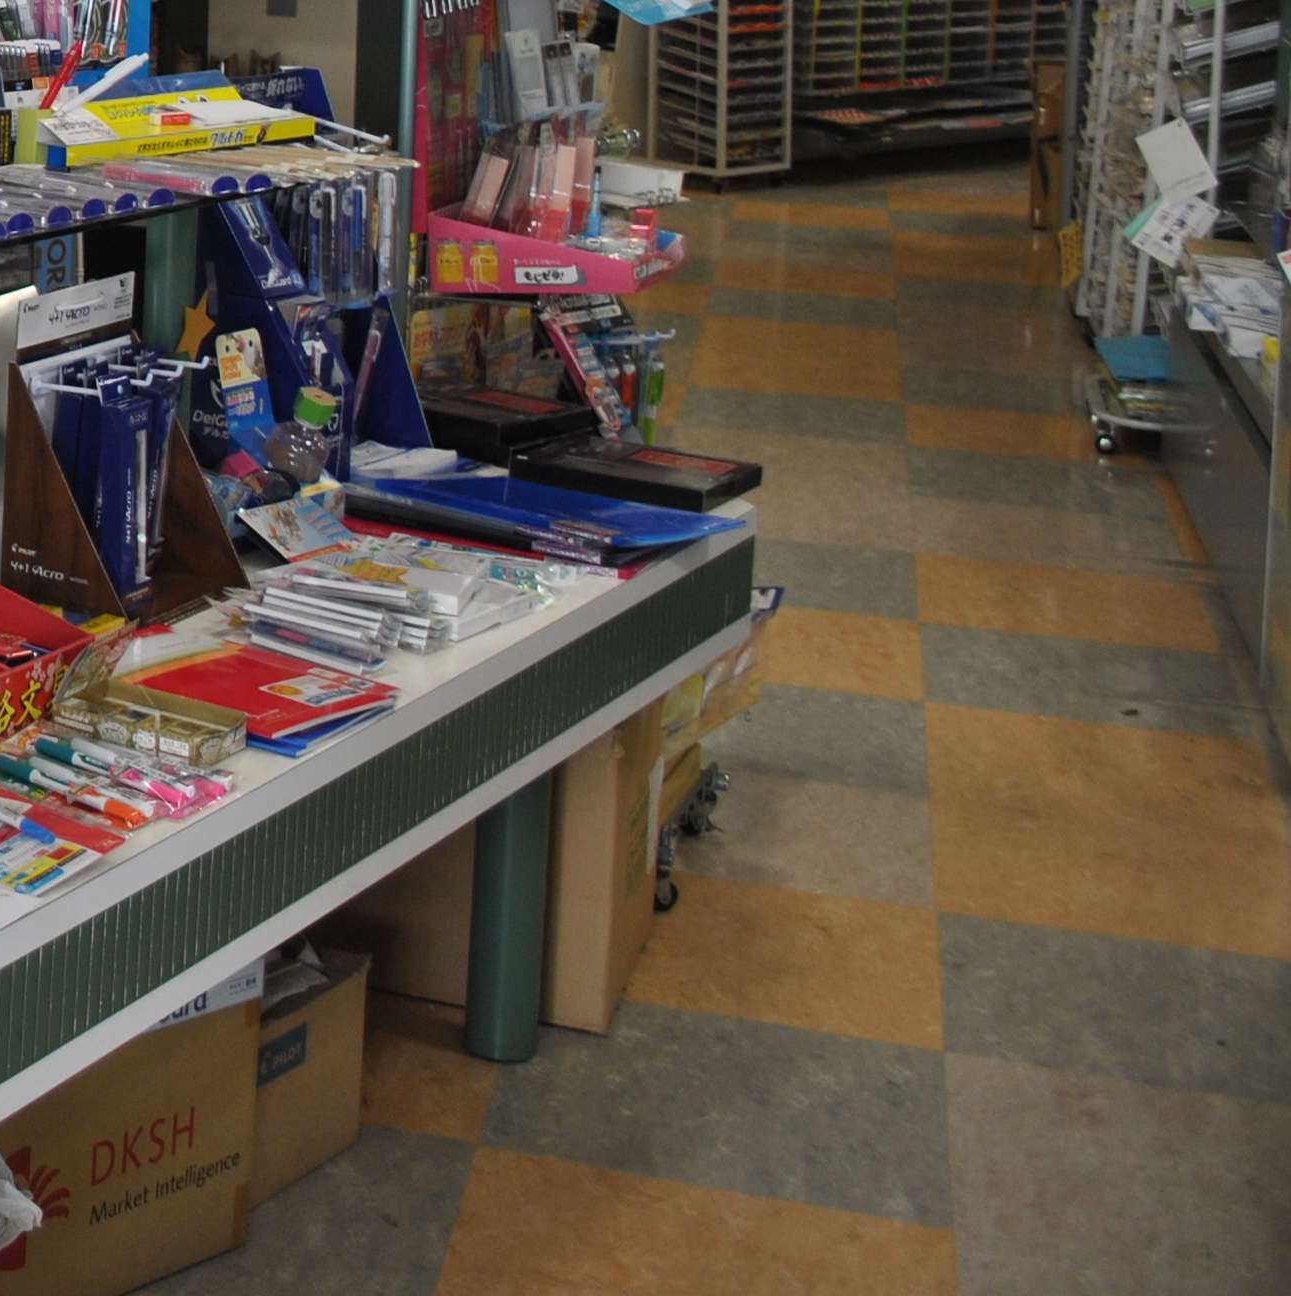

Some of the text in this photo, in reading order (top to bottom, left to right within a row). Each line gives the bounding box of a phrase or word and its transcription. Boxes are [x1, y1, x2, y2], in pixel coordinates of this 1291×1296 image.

[89, 1107, 197, 1187] DKSH
[88, 1151, 242, 1227] Market Intelligence
